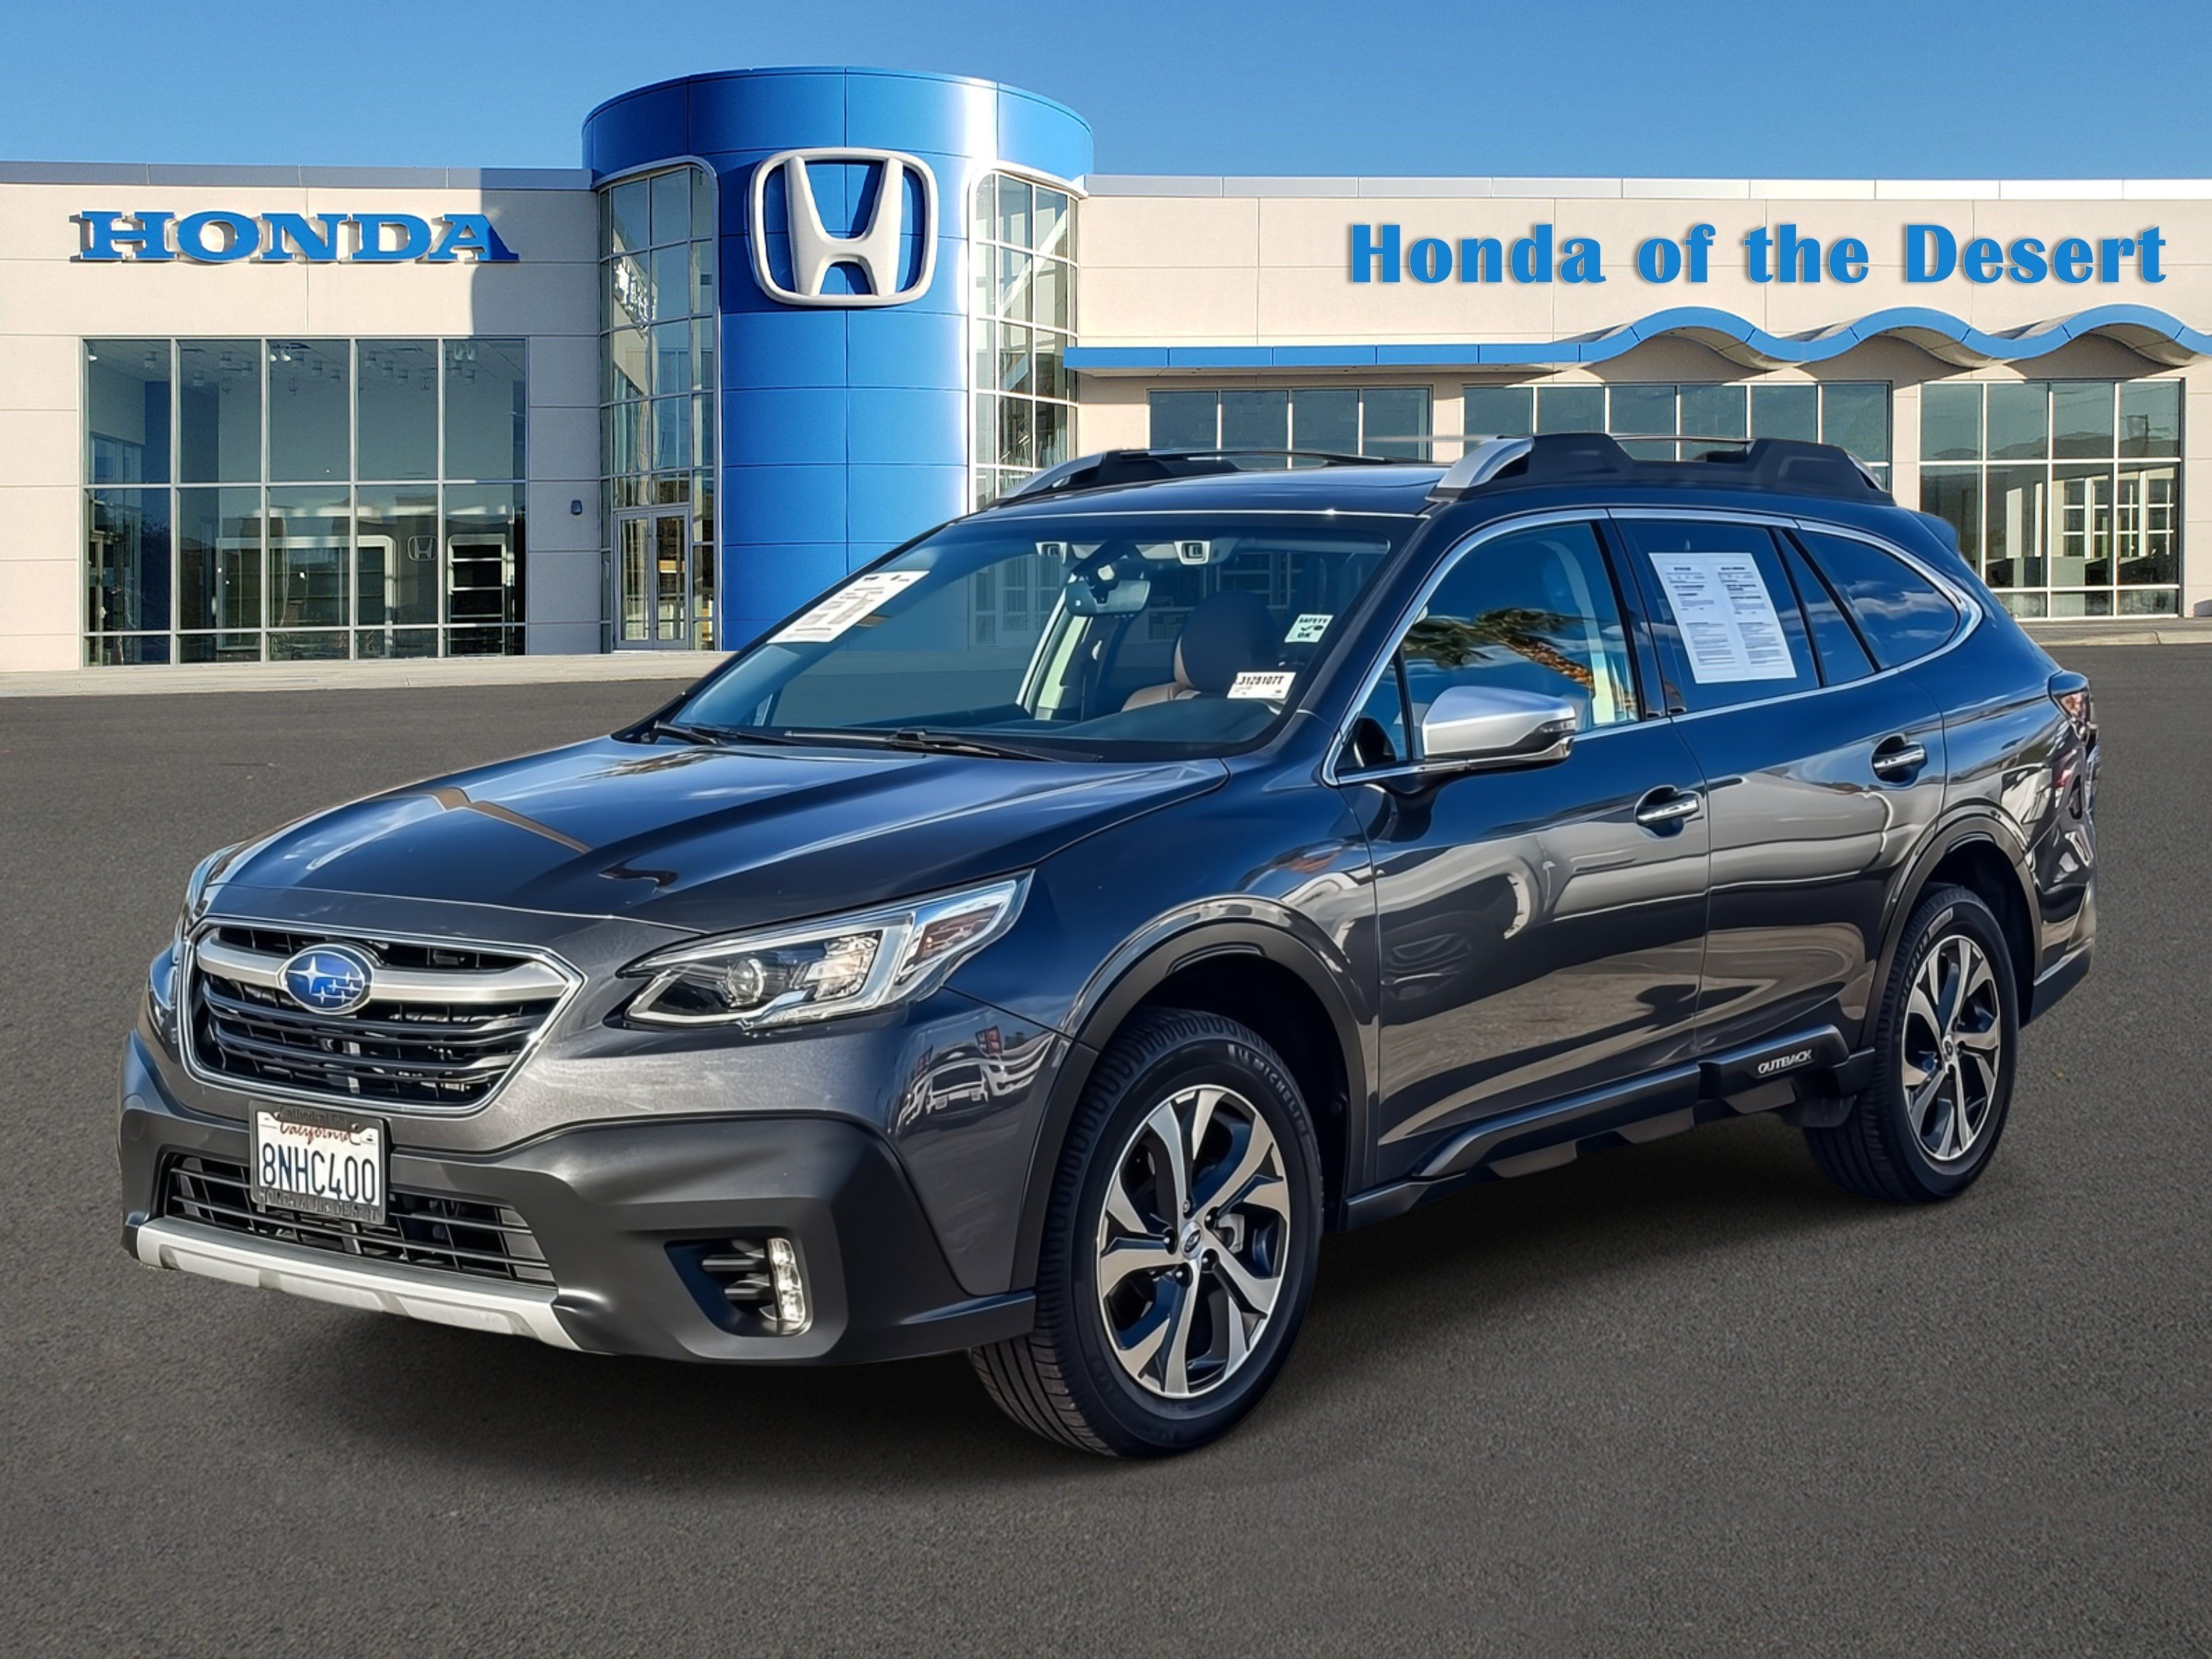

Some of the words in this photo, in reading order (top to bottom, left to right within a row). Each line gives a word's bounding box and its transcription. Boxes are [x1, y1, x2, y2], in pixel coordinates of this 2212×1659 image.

[80, 210, 519, 261] HONDA
[1351, 223, 1607, 284] Honda
[1637, 223, 1717, 284] of
[1743, 223, 1869, 284] the
[1905, 223, 2168, 284] Desert
[1757, 1049, 1812, 1074] OUTBACK
[1253, 1058, 1307, 1133] MICHELIN
[262, 1142, 375, 1203] 8NHC400
